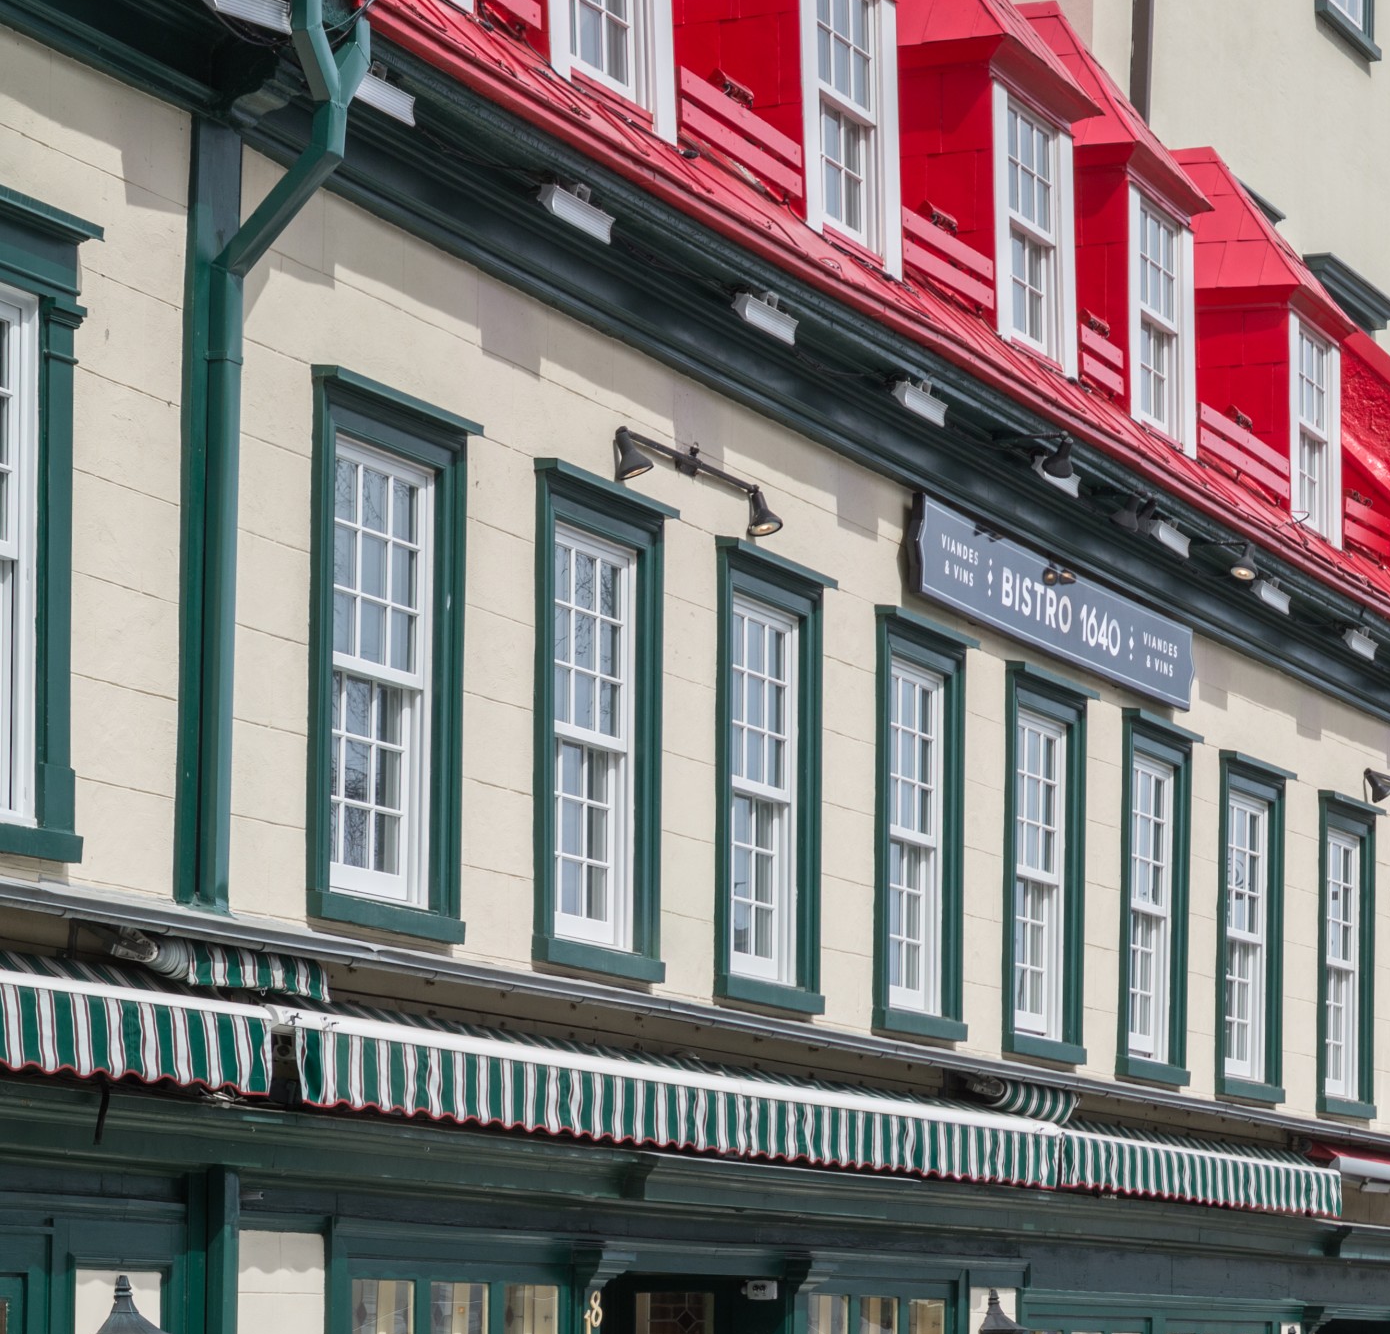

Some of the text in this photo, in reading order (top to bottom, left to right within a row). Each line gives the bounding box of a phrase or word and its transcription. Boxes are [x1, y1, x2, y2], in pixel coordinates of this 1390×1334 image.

[941, 533, 979, 565] VIANDES
[944, 560, 974, 587] & VINS
[1001, 567, 1120, 656] BISTRO 1640
[1143, 632, 1178, 658] VIANDES
[1146, 655, 1173, 677] & VINS
